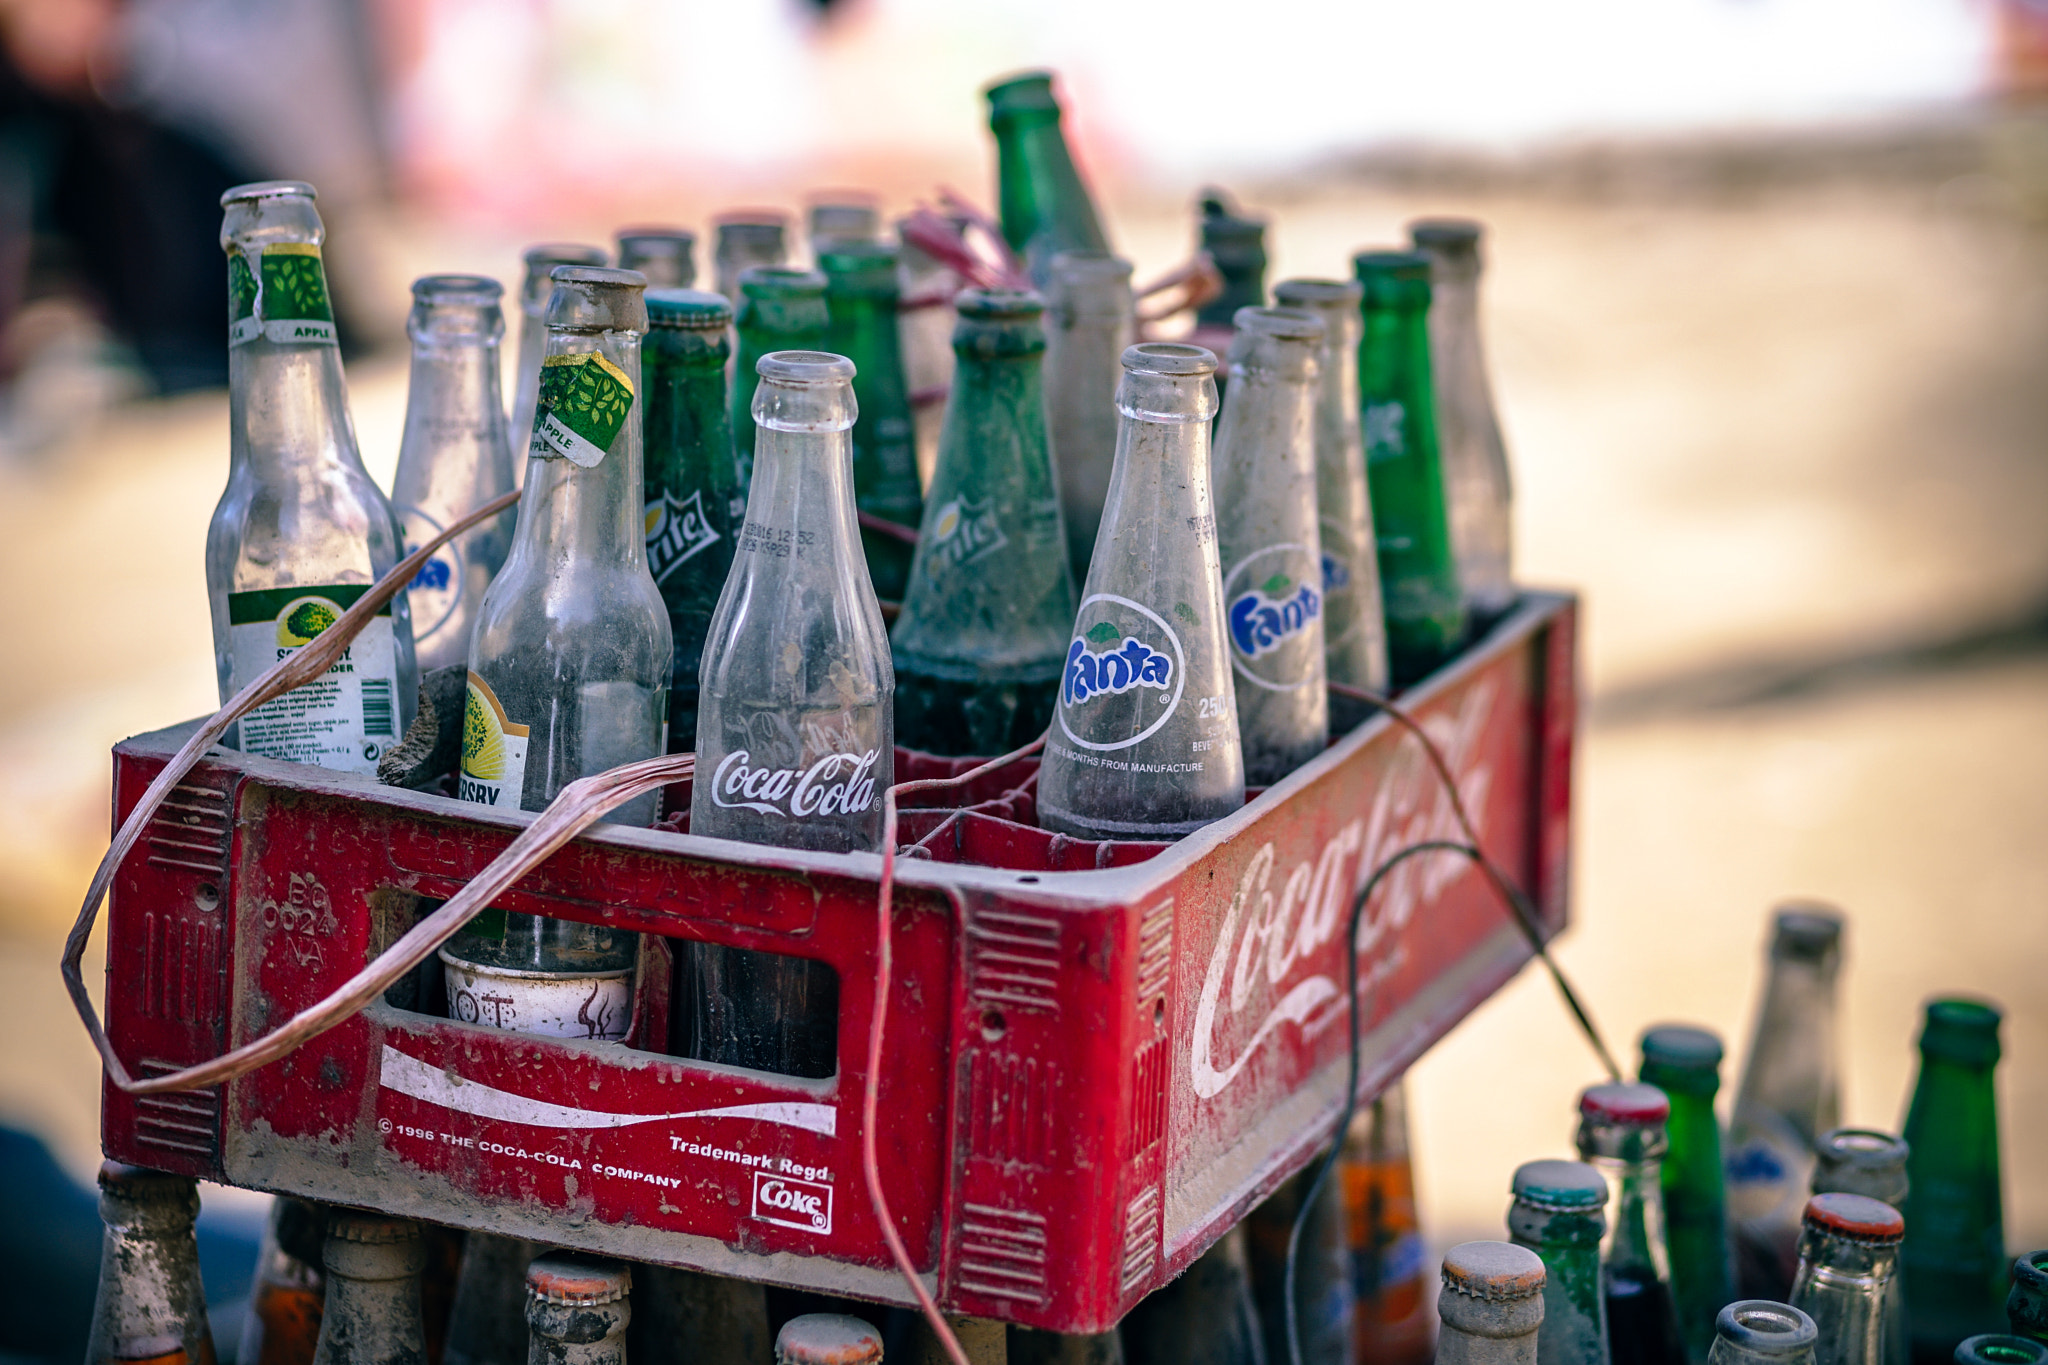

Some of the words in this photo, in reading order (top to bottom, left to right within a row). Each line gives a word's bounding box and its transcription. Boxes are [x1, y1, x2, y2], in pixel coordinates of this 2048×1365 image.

[648, 511, 708, 575] rite
[326, 664, 354, 674] DER
[1064, 637, 1172, 708] Fanta
[1199, 695, 1226, 719] 250
[1067, 750, 1099, 767] MONTHS
[1101, 758, 1129, 772] FROM
[1131, 762, 1204, 773] MANUFACTURE
[712, 747, 881, 817] Coca-Cola
[456, 989, 515, 1028] OT
[396, 1124, 435, 1141] 1996
[440, 1132, 474, 1150] THE
[478, 1140, 582, 1171] COCA-COLA
[591, 1163, 682, 1189] COMPANY
[669, 1136, 772, 1169] Trademark
[760, 1181, 822, 1215] Coke
